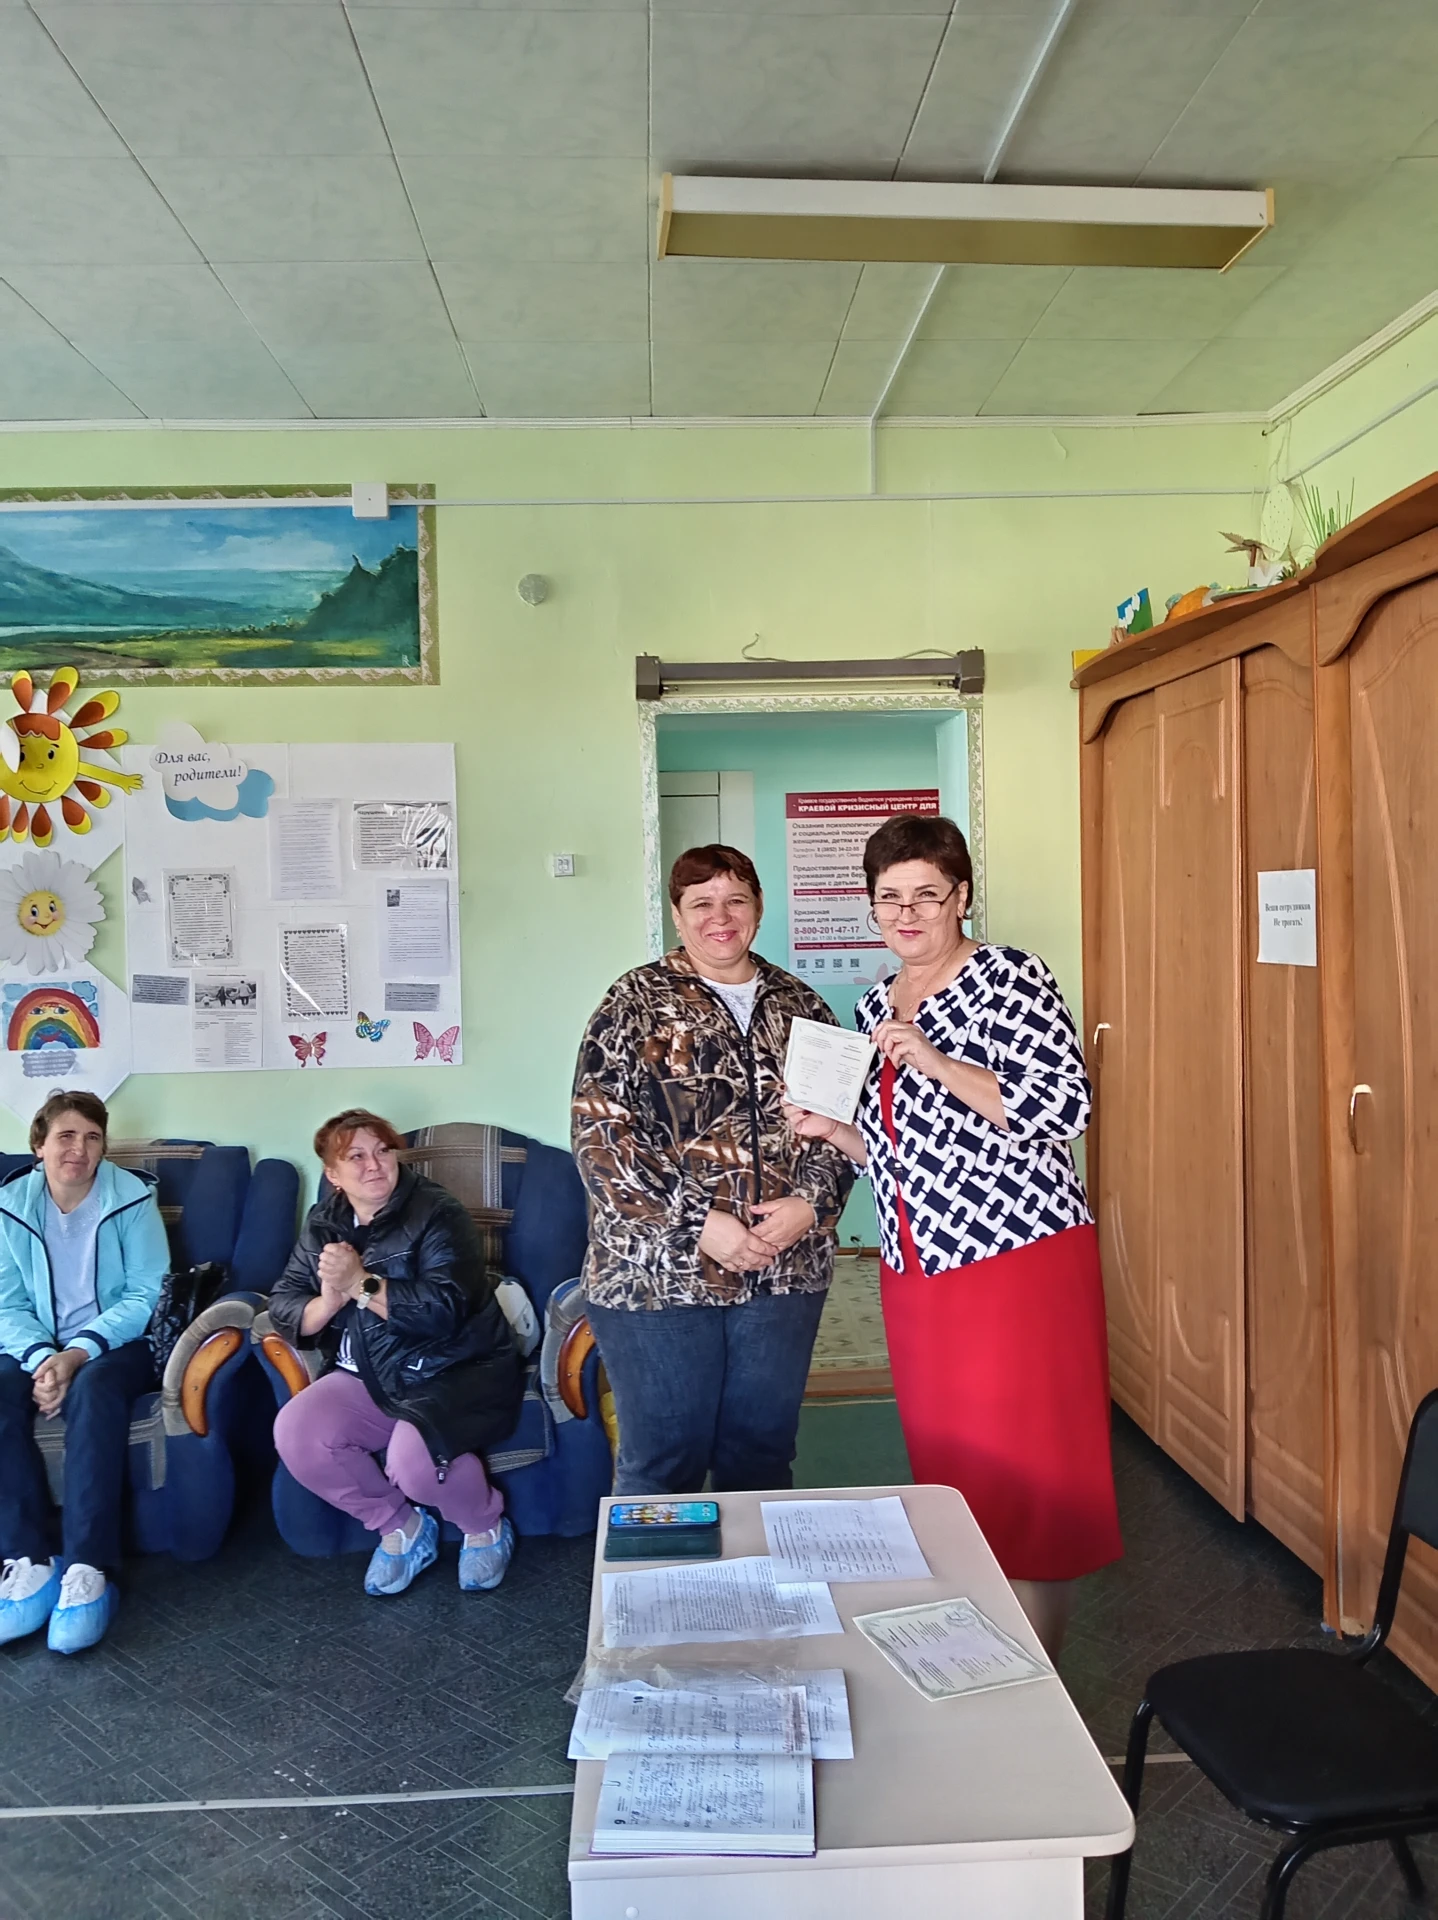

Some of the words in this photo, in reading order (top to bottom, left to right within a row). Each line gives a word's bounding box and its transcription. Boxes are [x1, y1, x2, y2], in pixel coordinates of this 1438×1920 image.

[154, 752, 184, 764] Для
[187, 752, 211, 763] вас,
[173, 765, 242, 786] родители!
[798, 804, 836, 812] КРАЕВОЙ
[838, 803, 889, 811] КРИЗИСНЫЙ
[890, 803, 918, 811] ЦЕНТР
[1273, 918, 1280, 926] Не
[1281, 918, 1303, 928] трогать!
[794, 926, 860, 934] 8-800-201-47-17
